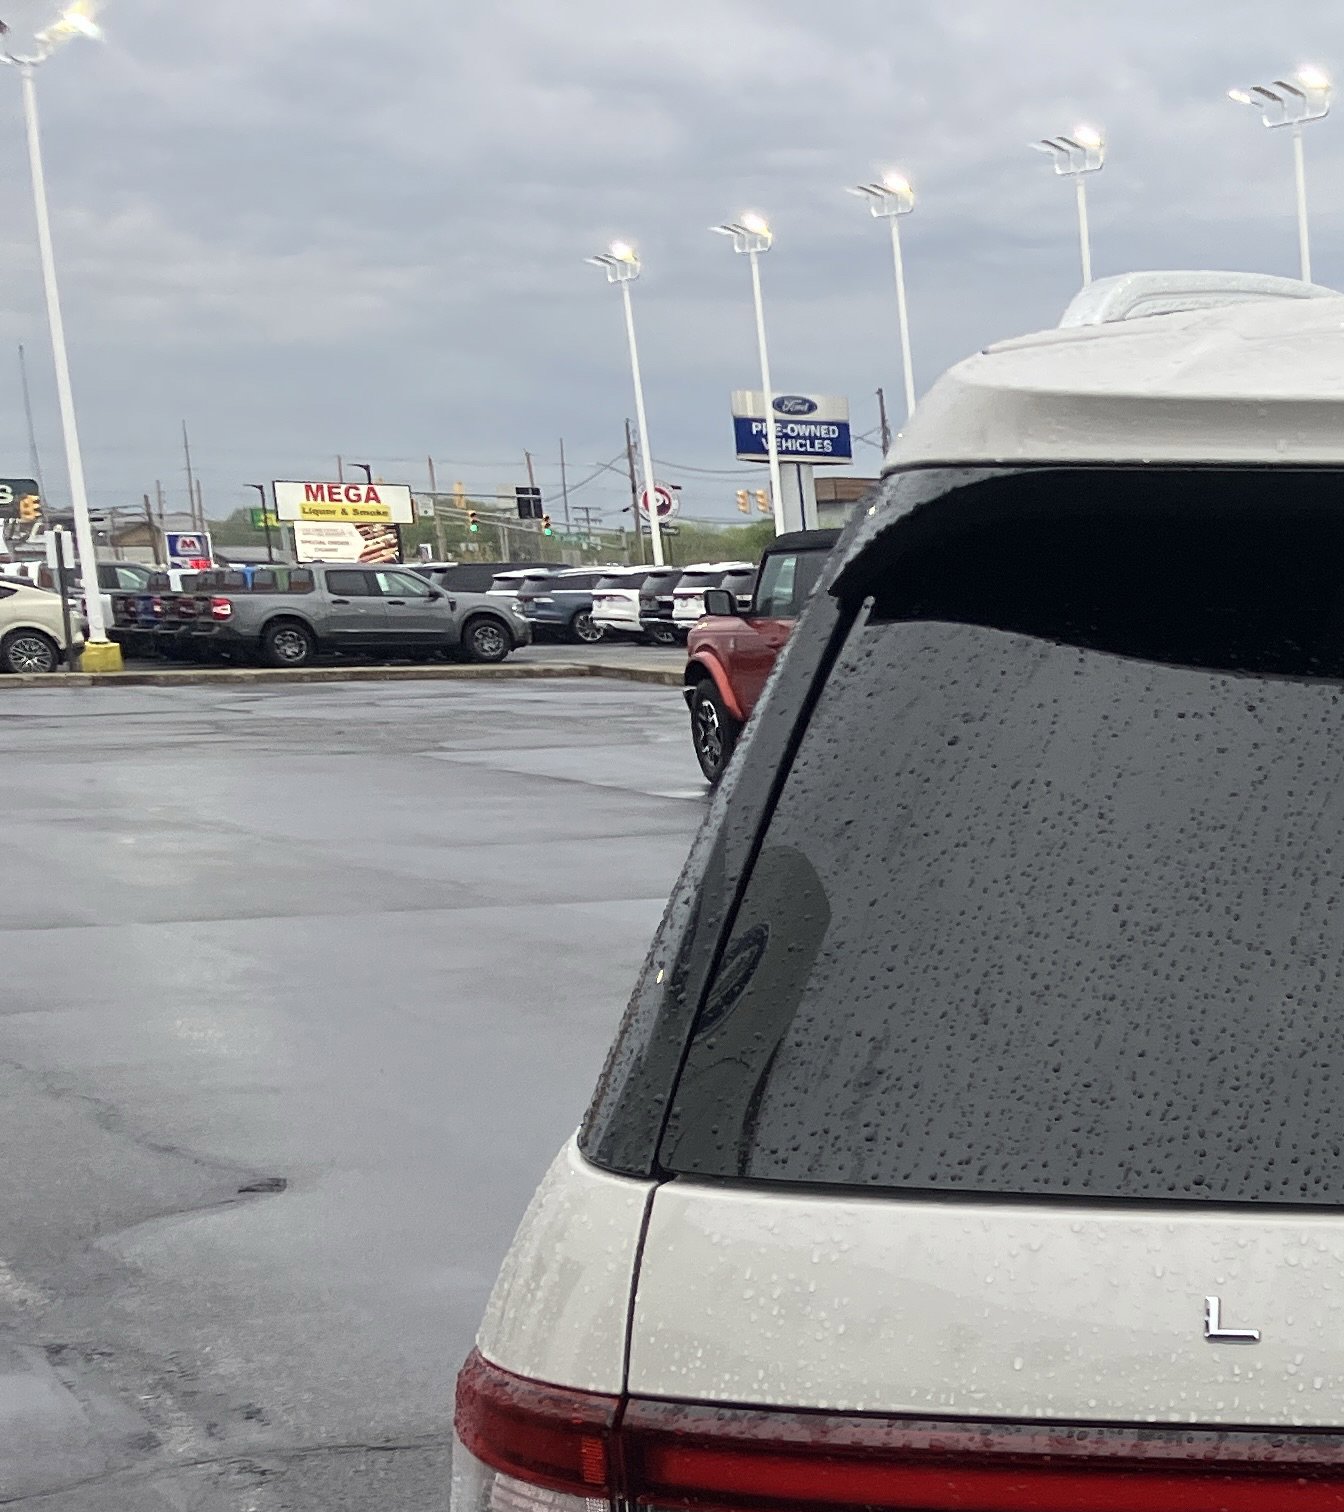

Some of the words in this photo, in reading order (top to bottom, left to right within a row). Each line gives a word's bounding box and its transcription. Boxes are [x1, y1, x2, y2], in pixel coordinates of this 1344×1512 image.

[304, 484, 382, 504] MEGA
[302, 507, 336, 516] Liquor
[353, 508, 389, 517] Smoke
